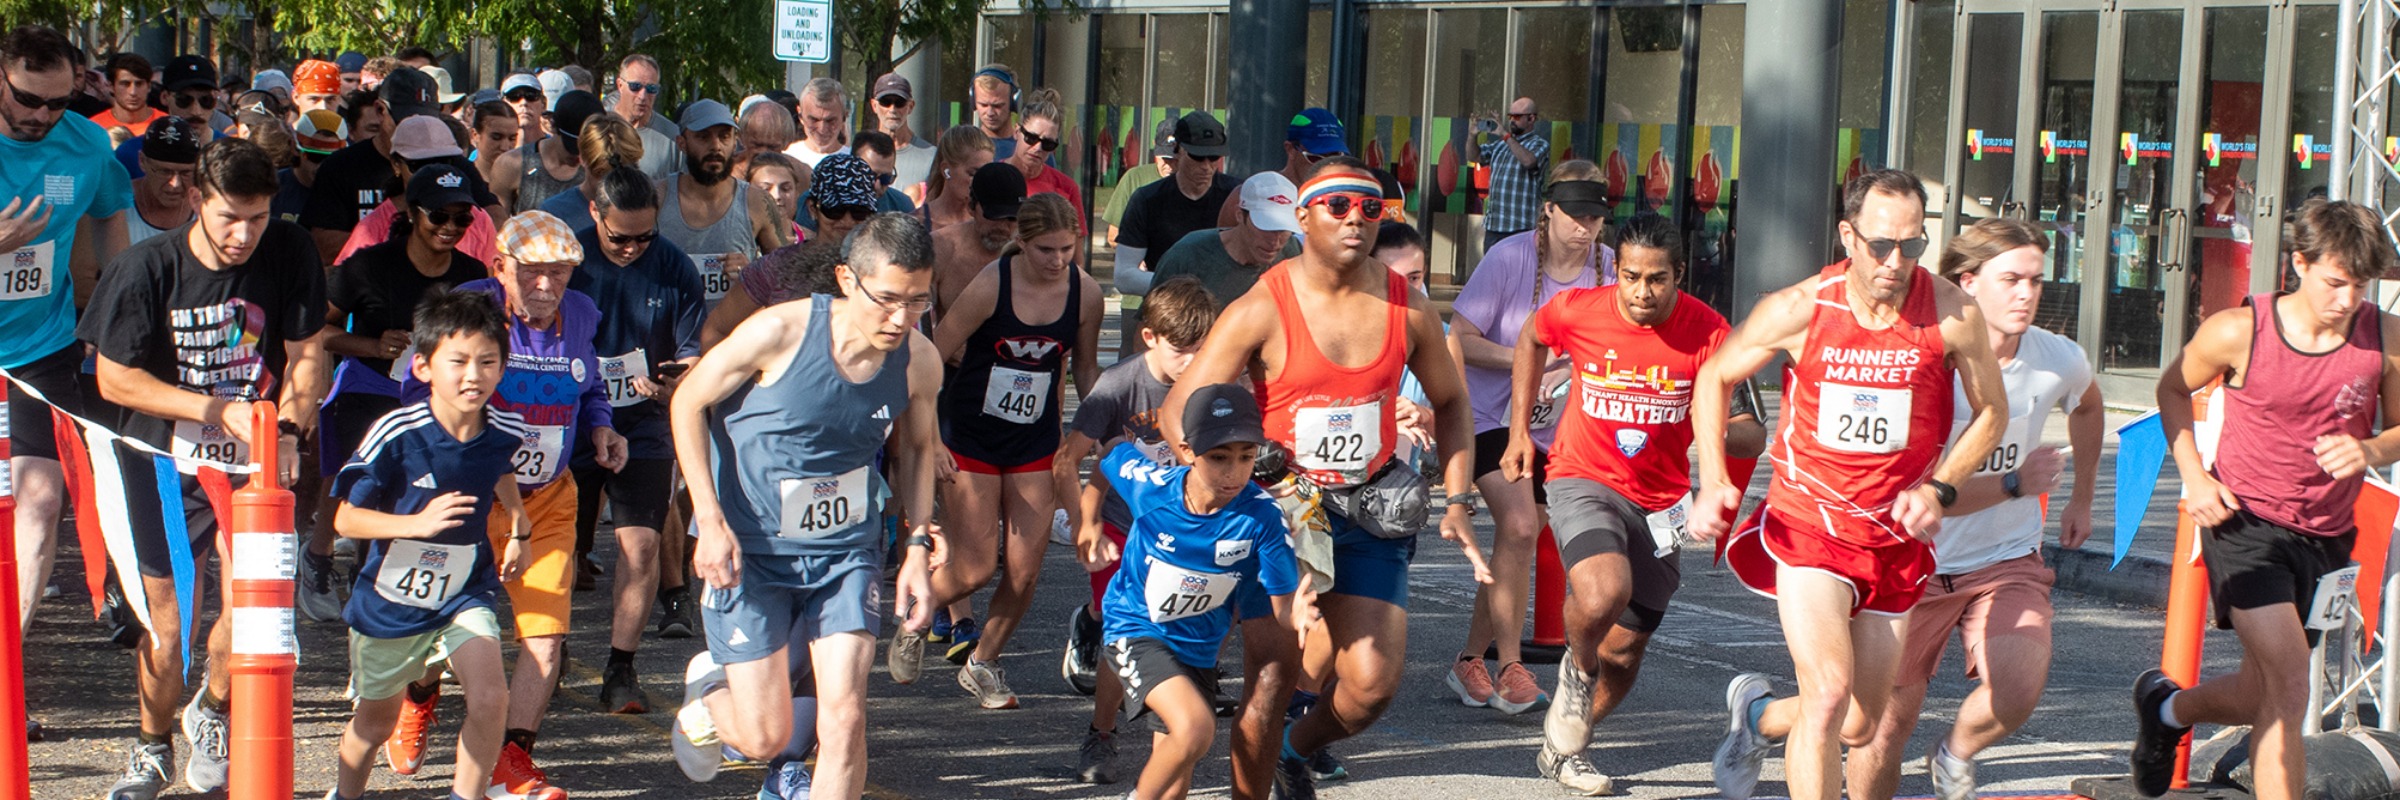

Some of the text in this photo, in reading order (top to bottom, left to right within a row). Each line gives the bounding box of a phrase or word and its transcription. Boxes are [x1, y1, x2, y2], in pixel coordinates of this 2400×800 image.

[787, 6, 819, 18] LOADING
[795, 19, 811, 29] AND
[781, 29, 823, 42] UNLOADING
[791, 41, 811, 52] ONLY
[2003, 139, 2014, 147] FAIR
[2077, 140, 2088, 148] FAIR
[2160, 142, 2172, 151] FAIR
[2244, 143, 2257, 151] FAIR
[358, 189, 374, 204] IN
[4, 266, 42, 294] 189
[170, 303, 237, 328] IN THIS
[173, 323, 236, 347] FAMILY
[176, 343, 257, 366] WE FIGHT
[1004, 340, 1059, 359] W
[1821, 346, 1920, 366] RUNNERS
[177, 362, 263, 387] TOGETHER
[540, 363, 570, 372] CENTERS
[1825, 364, 1917, 383] MARKET
[998, 391, 1036, 417] 449
[1618, 393, 1649, 403] HEALTH
[1530, 404, 1553, 424] 82
[1582, 394, 1690, 424] MARATHON
[1838, 413, 1889, 445] 246
[1315, 433, 1364, 463] 422
[515, 449, 545, 477] 23
[800, 496, 849, 532] 430
[396, 567, 451, 602] 431
[1158, 593, 1213, 616] 470
[2322, 593, 2347, 621] 42
